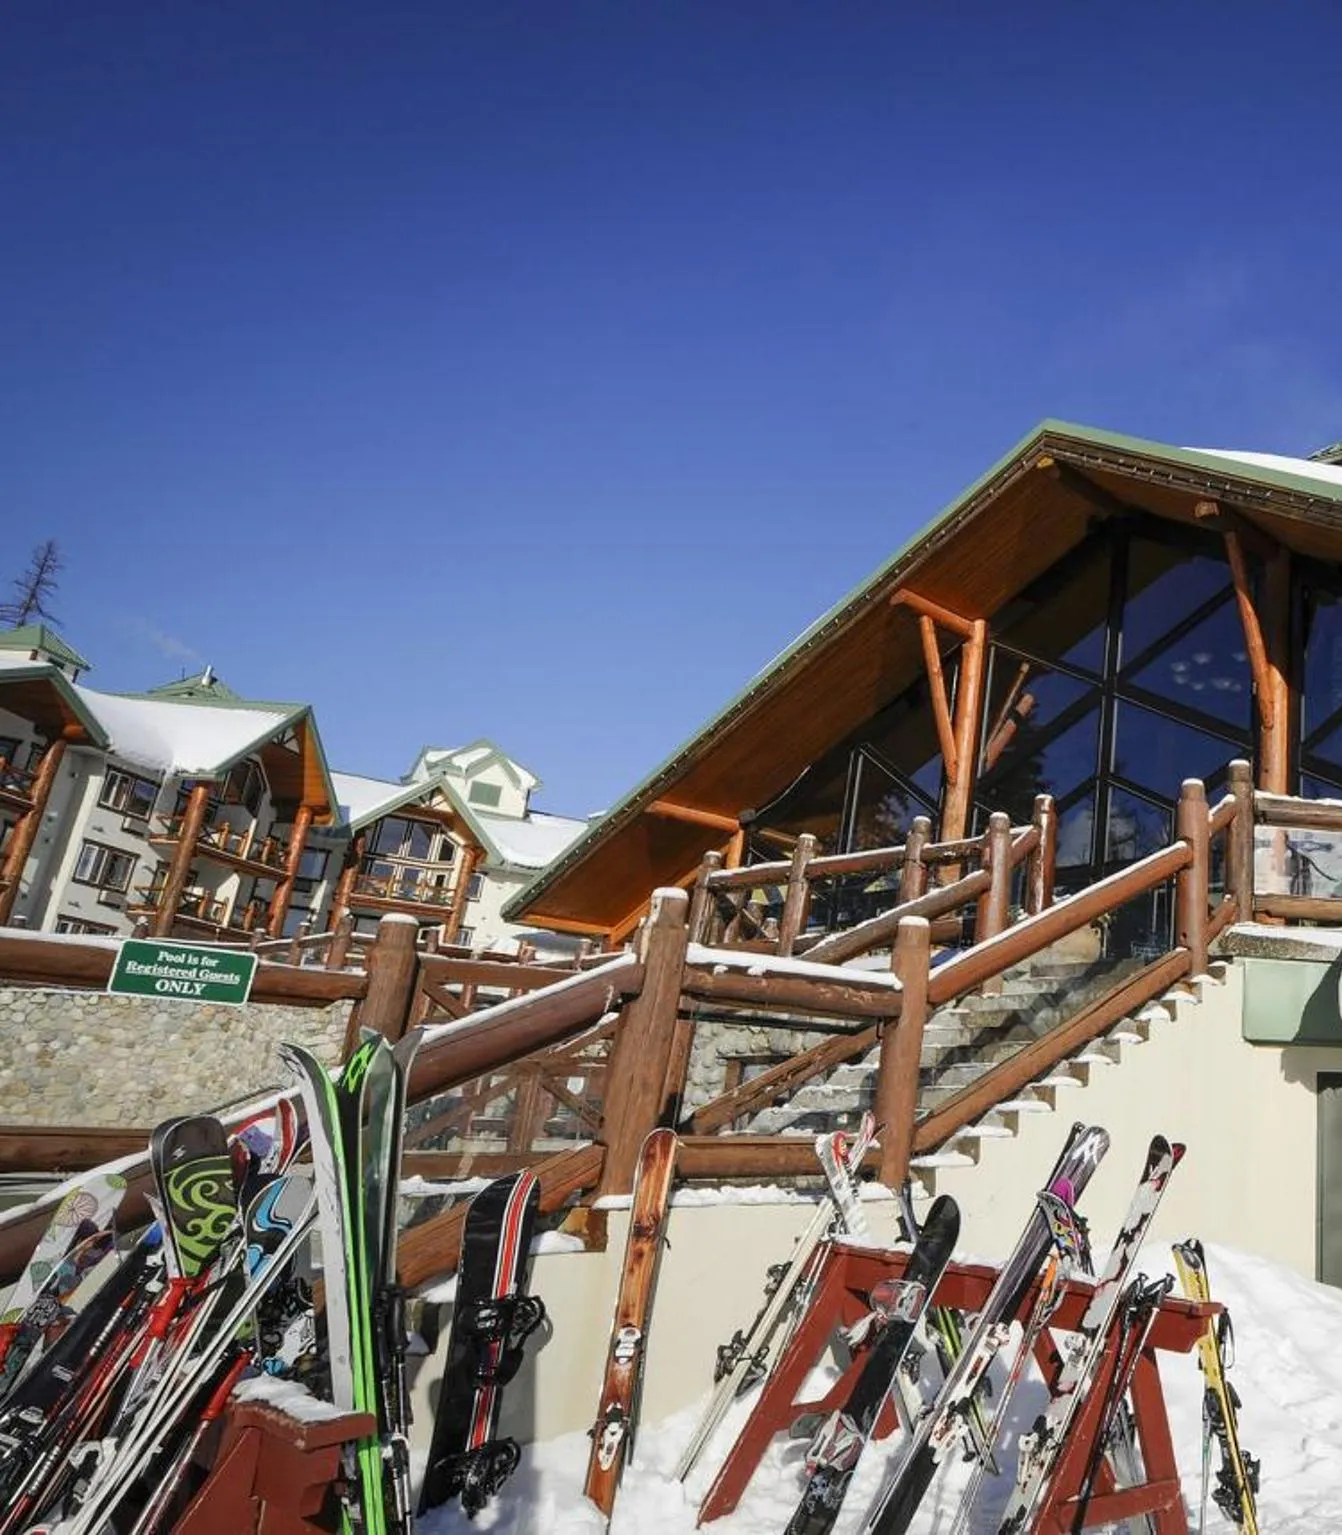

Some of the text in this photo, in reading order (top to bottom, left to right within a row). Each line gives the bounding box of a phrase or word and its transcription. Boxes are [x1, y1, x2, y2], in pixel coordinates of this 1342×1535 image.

[157, 951, 220, 967] Pool is for
[125, 961, 241, 985] Registered Guests
[155, 979, 208, 996] ONLY
